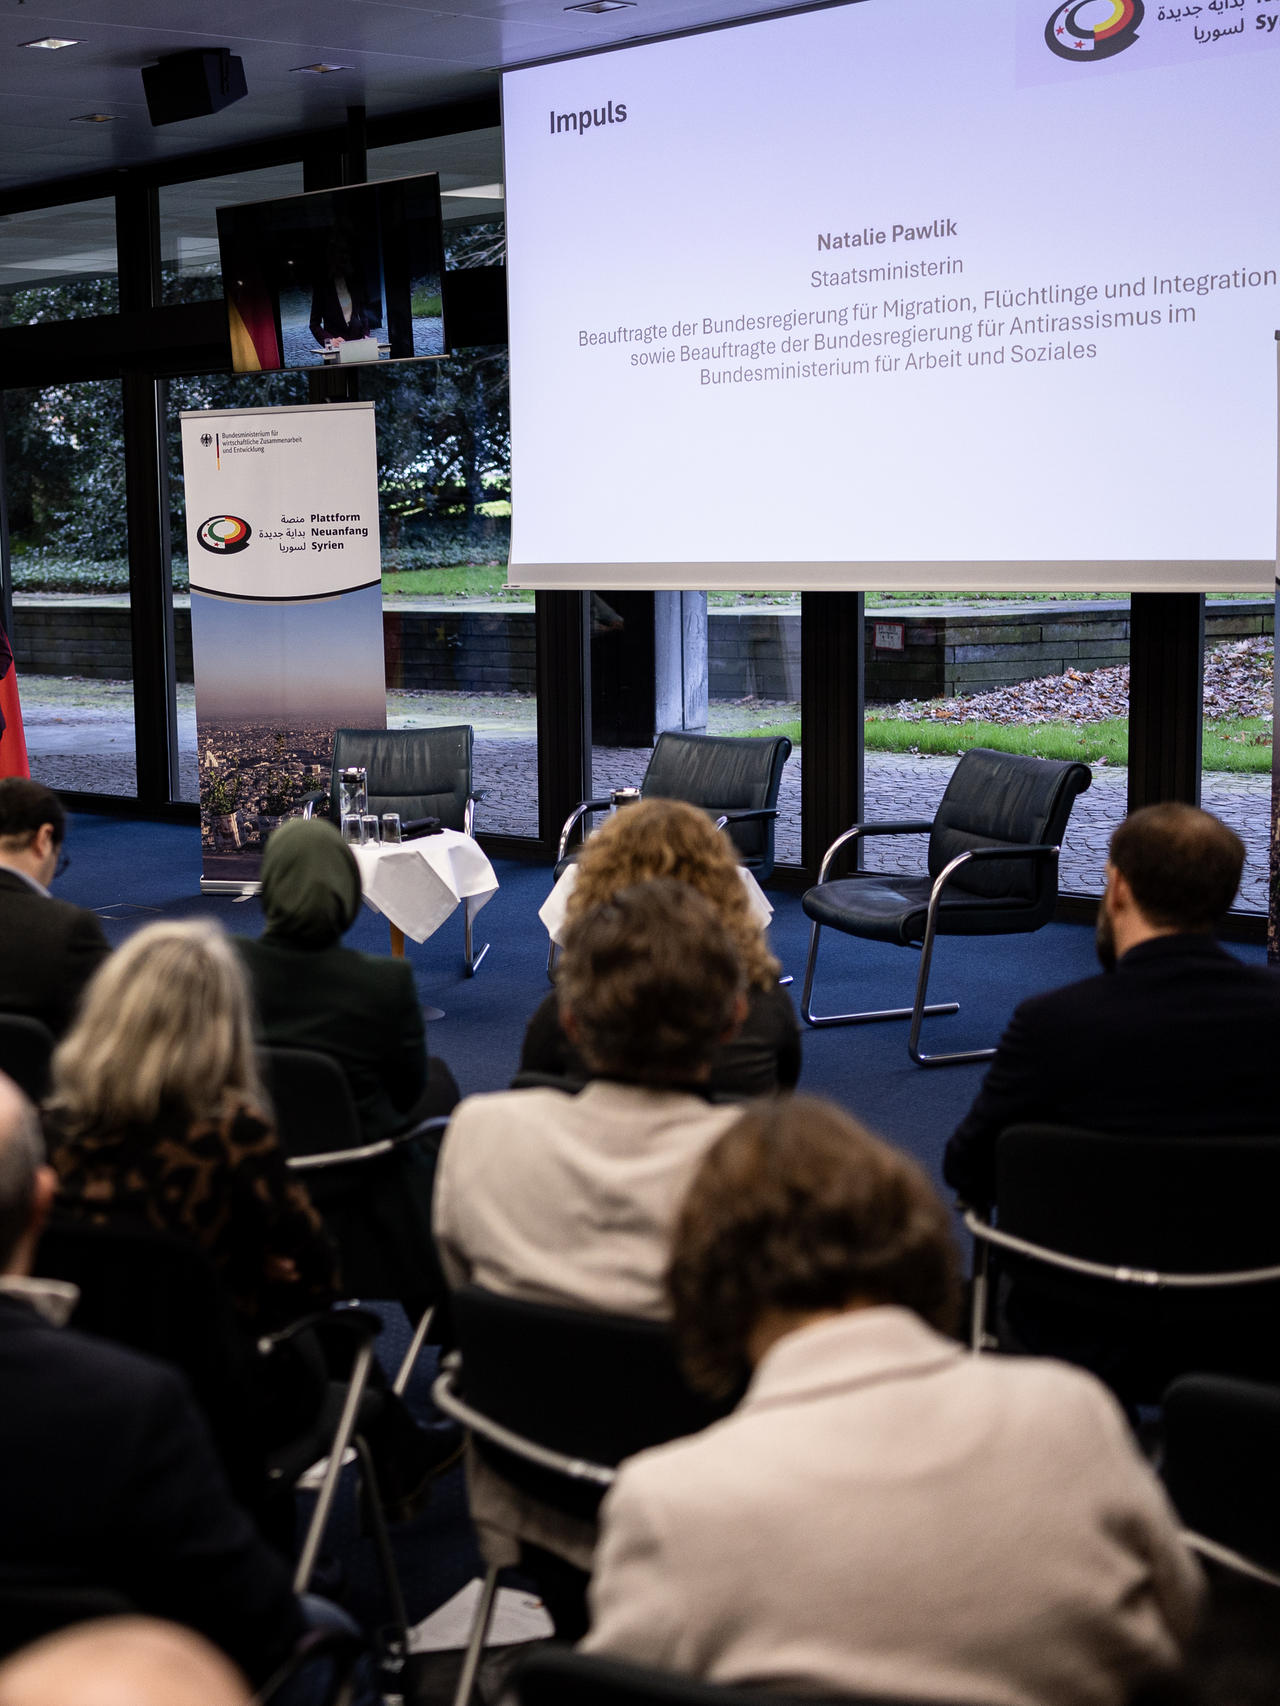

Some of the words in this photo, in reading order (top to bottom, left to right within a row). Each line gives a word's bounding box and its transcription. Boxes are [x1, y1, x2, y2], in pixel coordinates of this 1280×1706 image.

[1158, 6, 1202, 22] جديدة
[1256, 13, 1280, 32] Sy
[1195, 17, 1244, 43] لسوريا
[551, 101, 627, 135] Impuls
[818, 228, 886, 251] Natalie
[893, 219, 957, 242] Pawlik
[811, 256, 962, 287] Staatsministerin
[579, 325, 667, 347] Beauftragte
[672, 321, 698, 337] der
[703, 307, 848, 335] Bundesregierung
[853, 304, 878, 320] für
[884, 295, 976, 320] Migration,
[985, 285, 1097, 309] Flüchtlinge
[1105, 277, 1145, 298] und
[1154, 268, 1276, 295] Integration
[631, 347, 675, 366] sowie
[681, 340, 775, 361] Beauftragte
[781, 336, 809, 353] der
[815, 323, 972, 351] Bundesregierung
[978, 320, 1005, 337] für
[1010, 310, 1161, 335] Antirassismus
[1169, 304, 1195, 323] im
[701, 358, 869, 385] Bundesministerium
[875, 355, 900, 372] für
[905, 349, 962, 370] Arbeit
[968, 346, 1004, 366] und
[1011, 341, 1096, 362] Soziales
[222, 431, 270, 439] Bundesministerium
[222, 438, 259, 446] wirtschaftliche
[260, 436, 302, 445] Zusammenarbeit
[233, 446, 265, 454] Entwicklung
[281, 515, 304, 523] منصة
[311, 513, 360, 522] Plattform
[259, 530, 283, 539] جديدة
[286, 528, 305, 539] بداية
[312, 527, 368, 537] Neuanfang
[280, 542, 306, 553] لسوريا
[312, 541, 344, 552] Syrien
